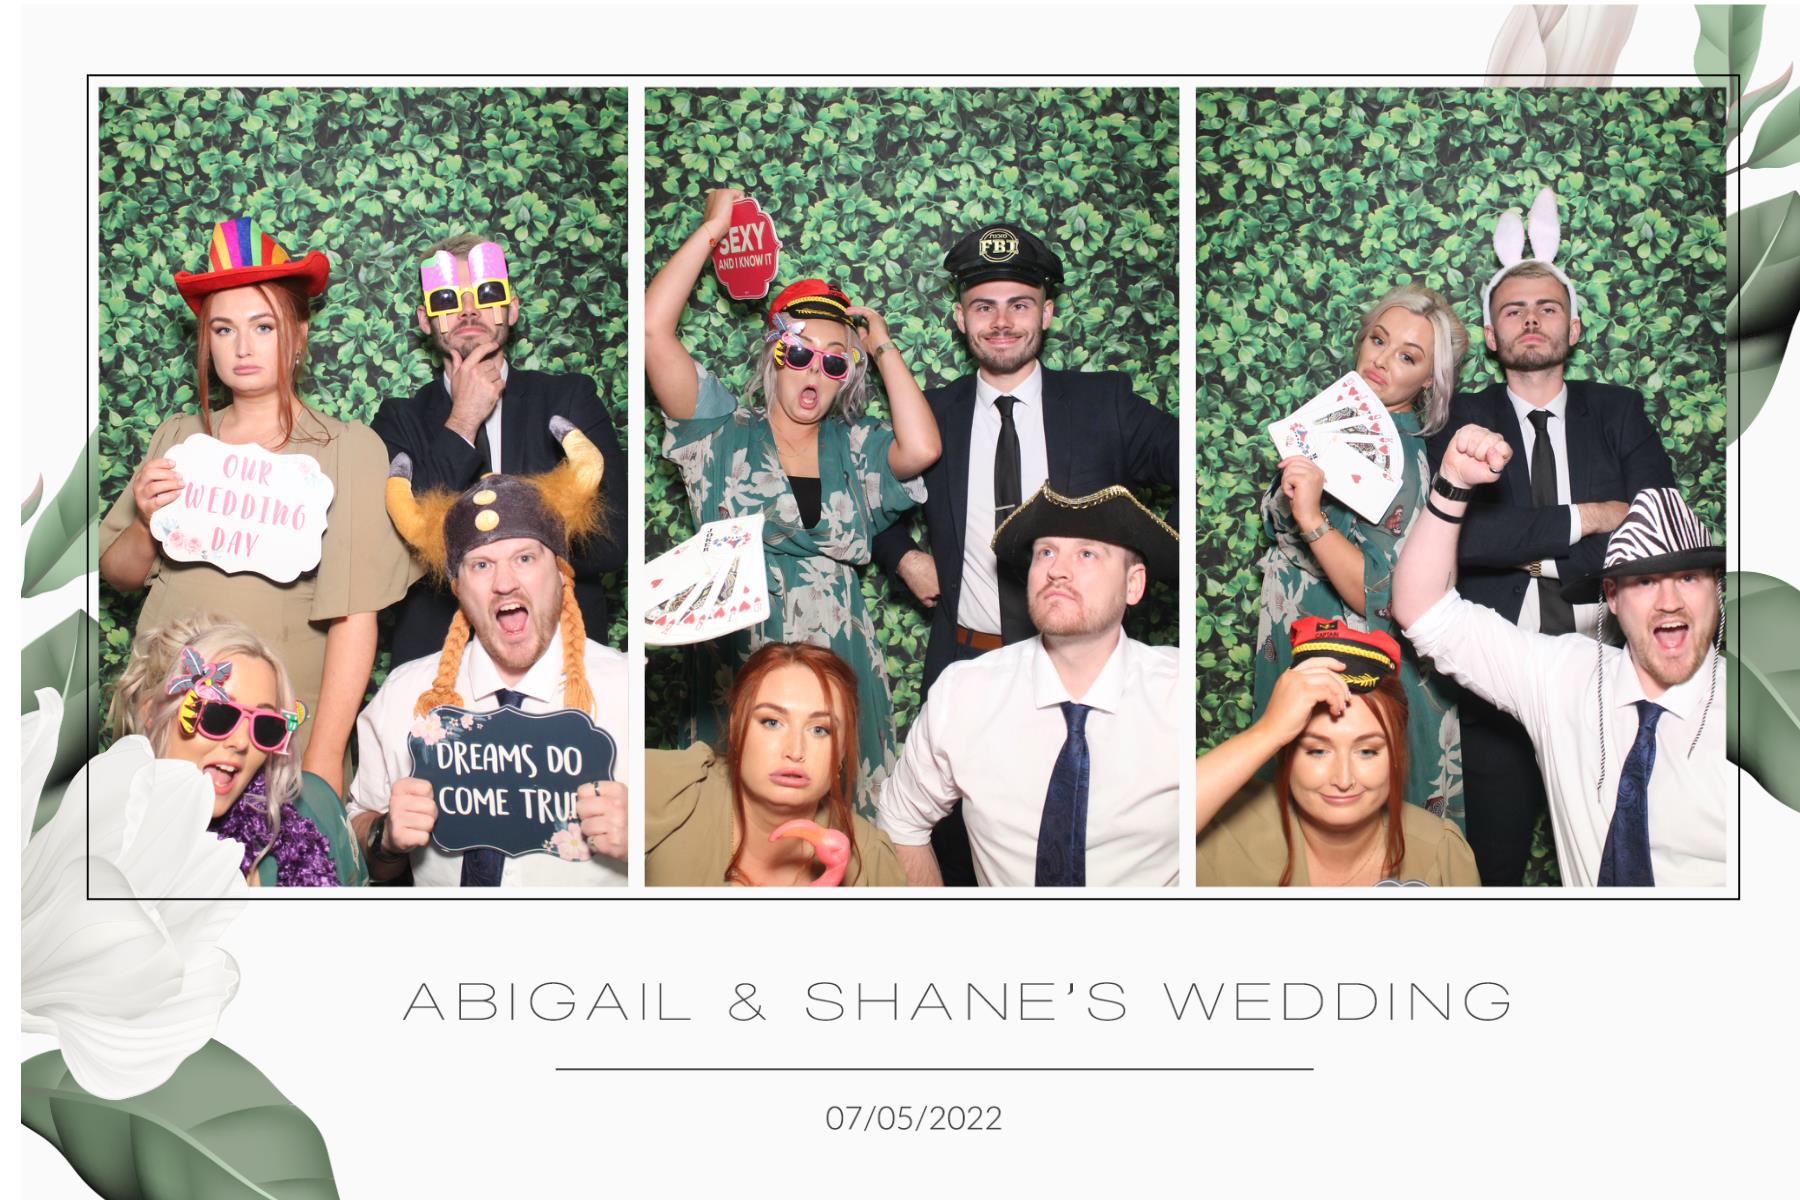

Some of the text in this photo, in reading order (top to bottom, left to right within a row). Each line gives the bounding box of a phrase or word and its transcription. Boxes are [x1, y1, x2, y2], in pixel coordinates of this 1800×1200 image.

[719, 222, 765, 256] SEXY
[980, 239, 1018, 254] FBI
[719, 258, 734, 270] AND
[740, 255, 763, 269] KNOW
[765, 253, 772, 265] IT
[223, 454, 272, 487] OUR
[184, 481, 306, 530] WEDDING
[210, 526, 260, 557] DAY
[703, 528, 714, 552] JOKER
[436, 741, 583, 778] DREAMS DO
[438, 786, 510, 817] COME
